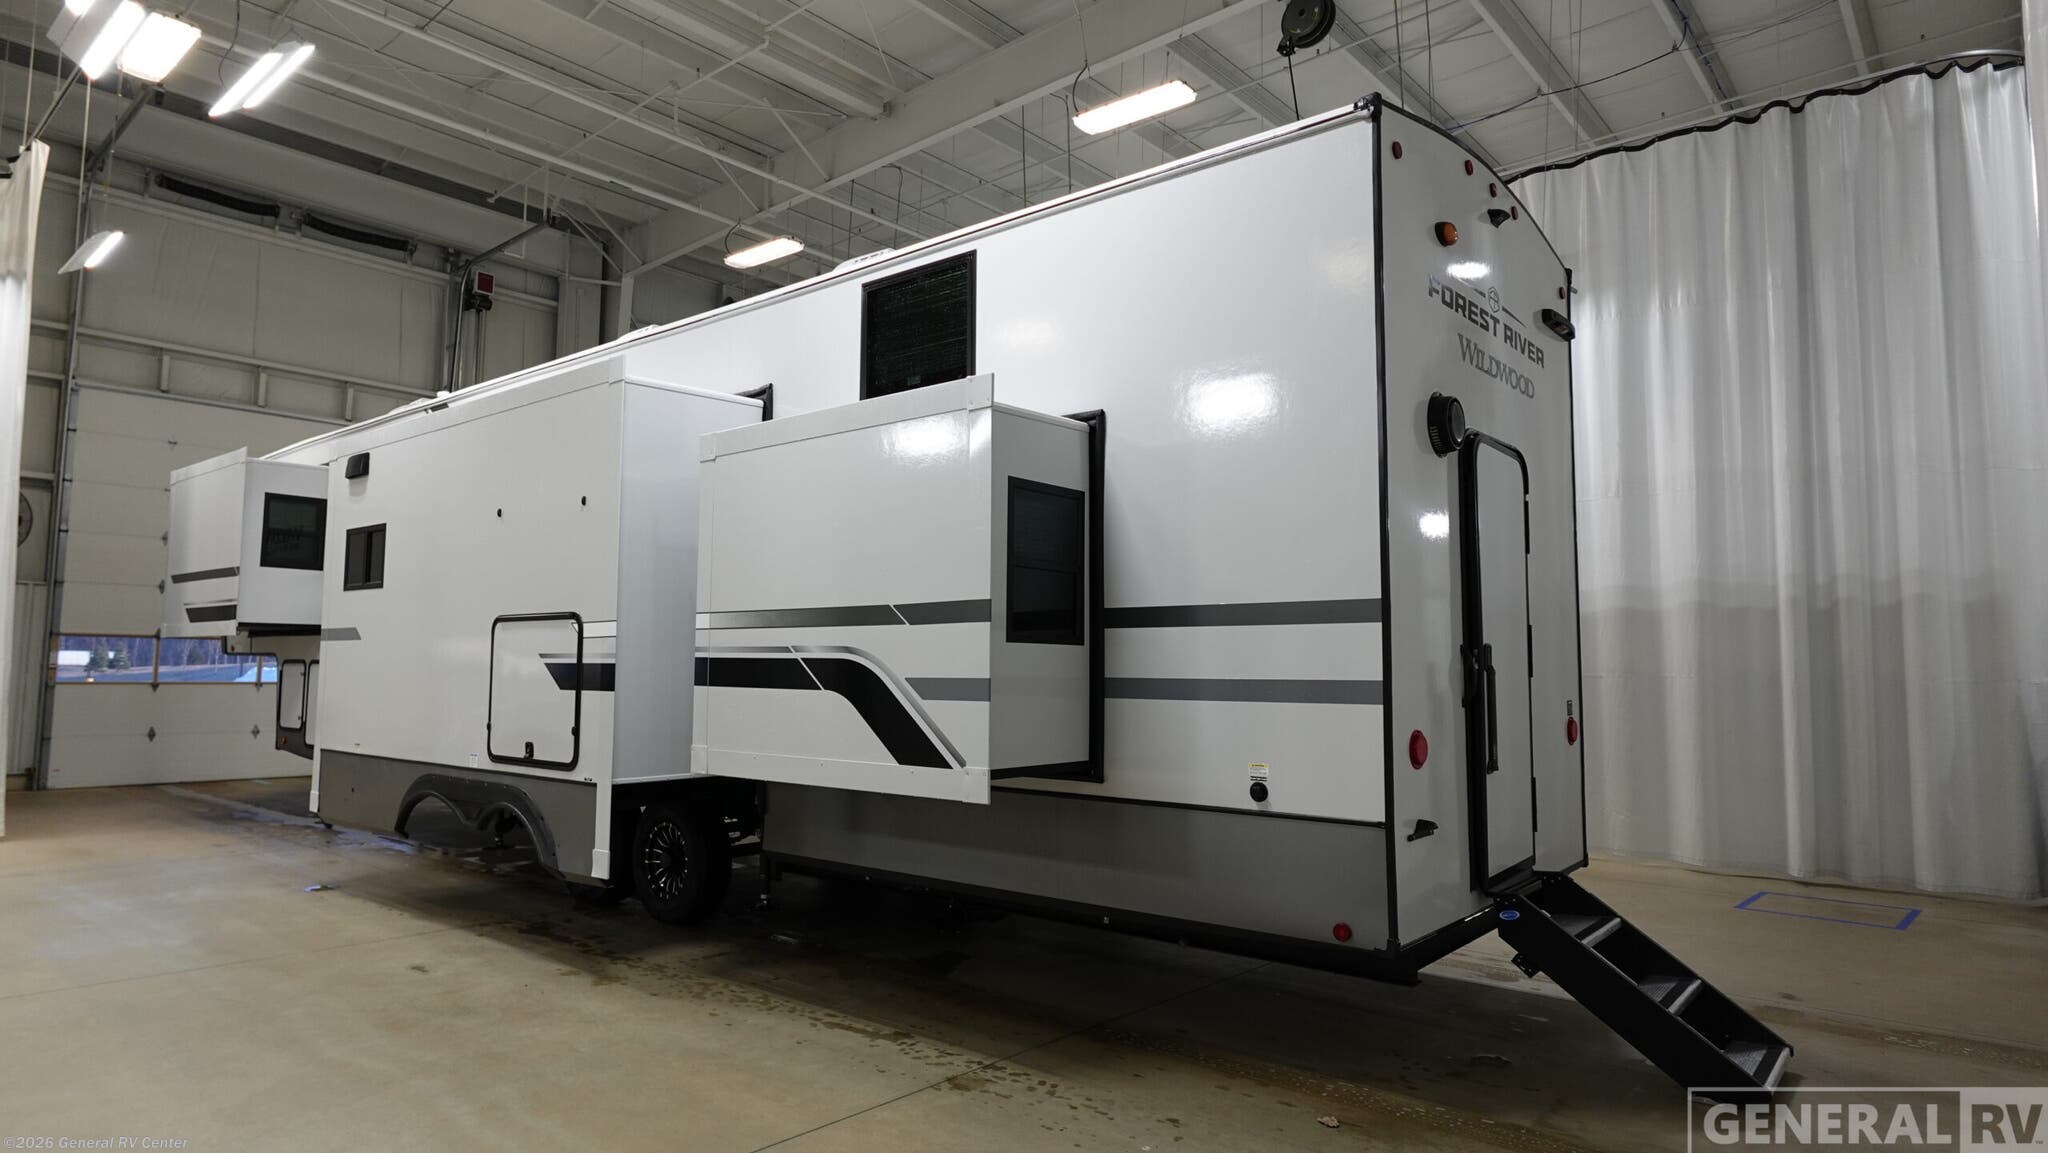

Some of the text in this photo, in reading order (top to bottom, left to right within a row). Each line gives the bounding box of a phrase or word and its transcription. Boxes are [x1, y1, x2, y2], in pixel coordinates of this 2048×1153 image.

[1428, 275, 1545, 369] FOREST RIVER
[1457, 332, 1535, 399] WILDWOOD
